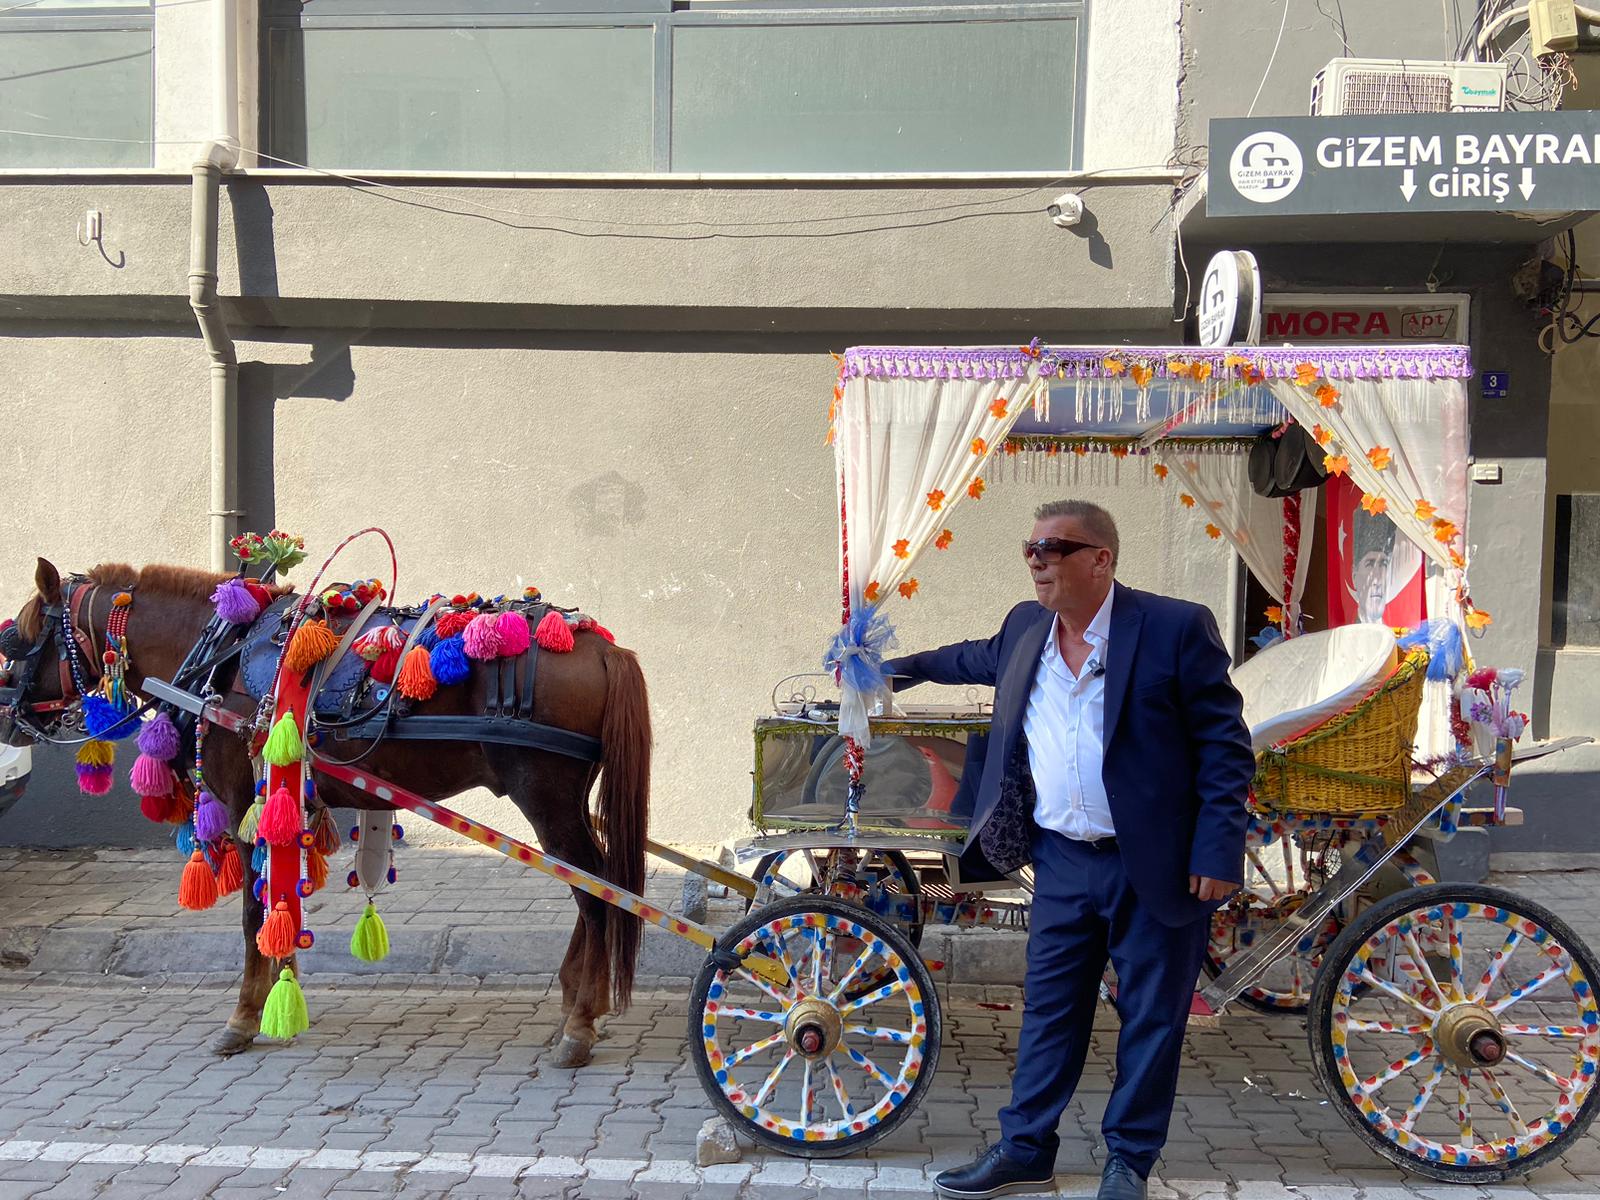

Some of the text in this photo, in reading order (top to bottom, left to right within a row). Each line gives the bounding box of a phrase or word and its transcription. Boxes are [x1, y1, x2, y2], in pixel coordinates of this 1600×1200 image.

[1316, 134, 1600, 168] GİZEM BAYRA
[1263, 169, 1294, 177] BAYRAK
[1428, 166, 1510, 203] GİRİŞ
[1266, 311, 1390, 336] MORA
[1490, 375, 1497, 388] 3
